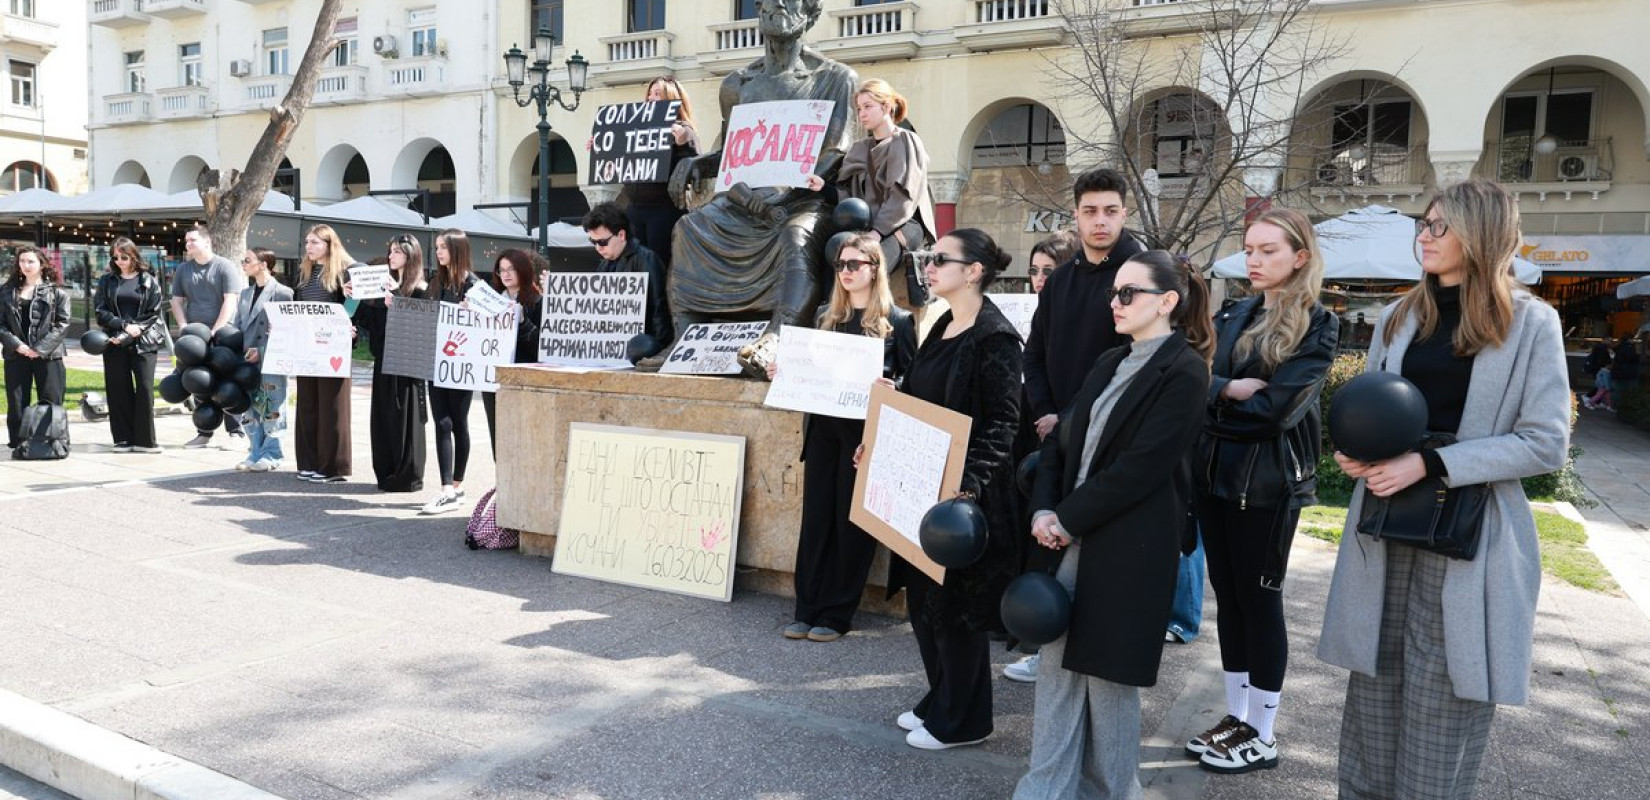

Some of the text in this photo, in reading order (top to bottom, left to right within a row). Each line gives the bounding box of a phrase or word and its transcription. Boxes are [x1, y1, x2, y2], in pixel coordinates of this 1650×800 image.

[596, 101, 682, 125] СОЛУН Е
[593, 128, 672, 152] СО ТЕБЕ
[594, 156, 658, 183] КОЧАНИ
[1533, 250, 1589, 261] GELATO
[440, 305, 480, 328] THEIR
[480, 339, 500, 357] OR
[438, 360, 475, 384] OUR
[566, 532, 626, 569] КОЧАНИ
